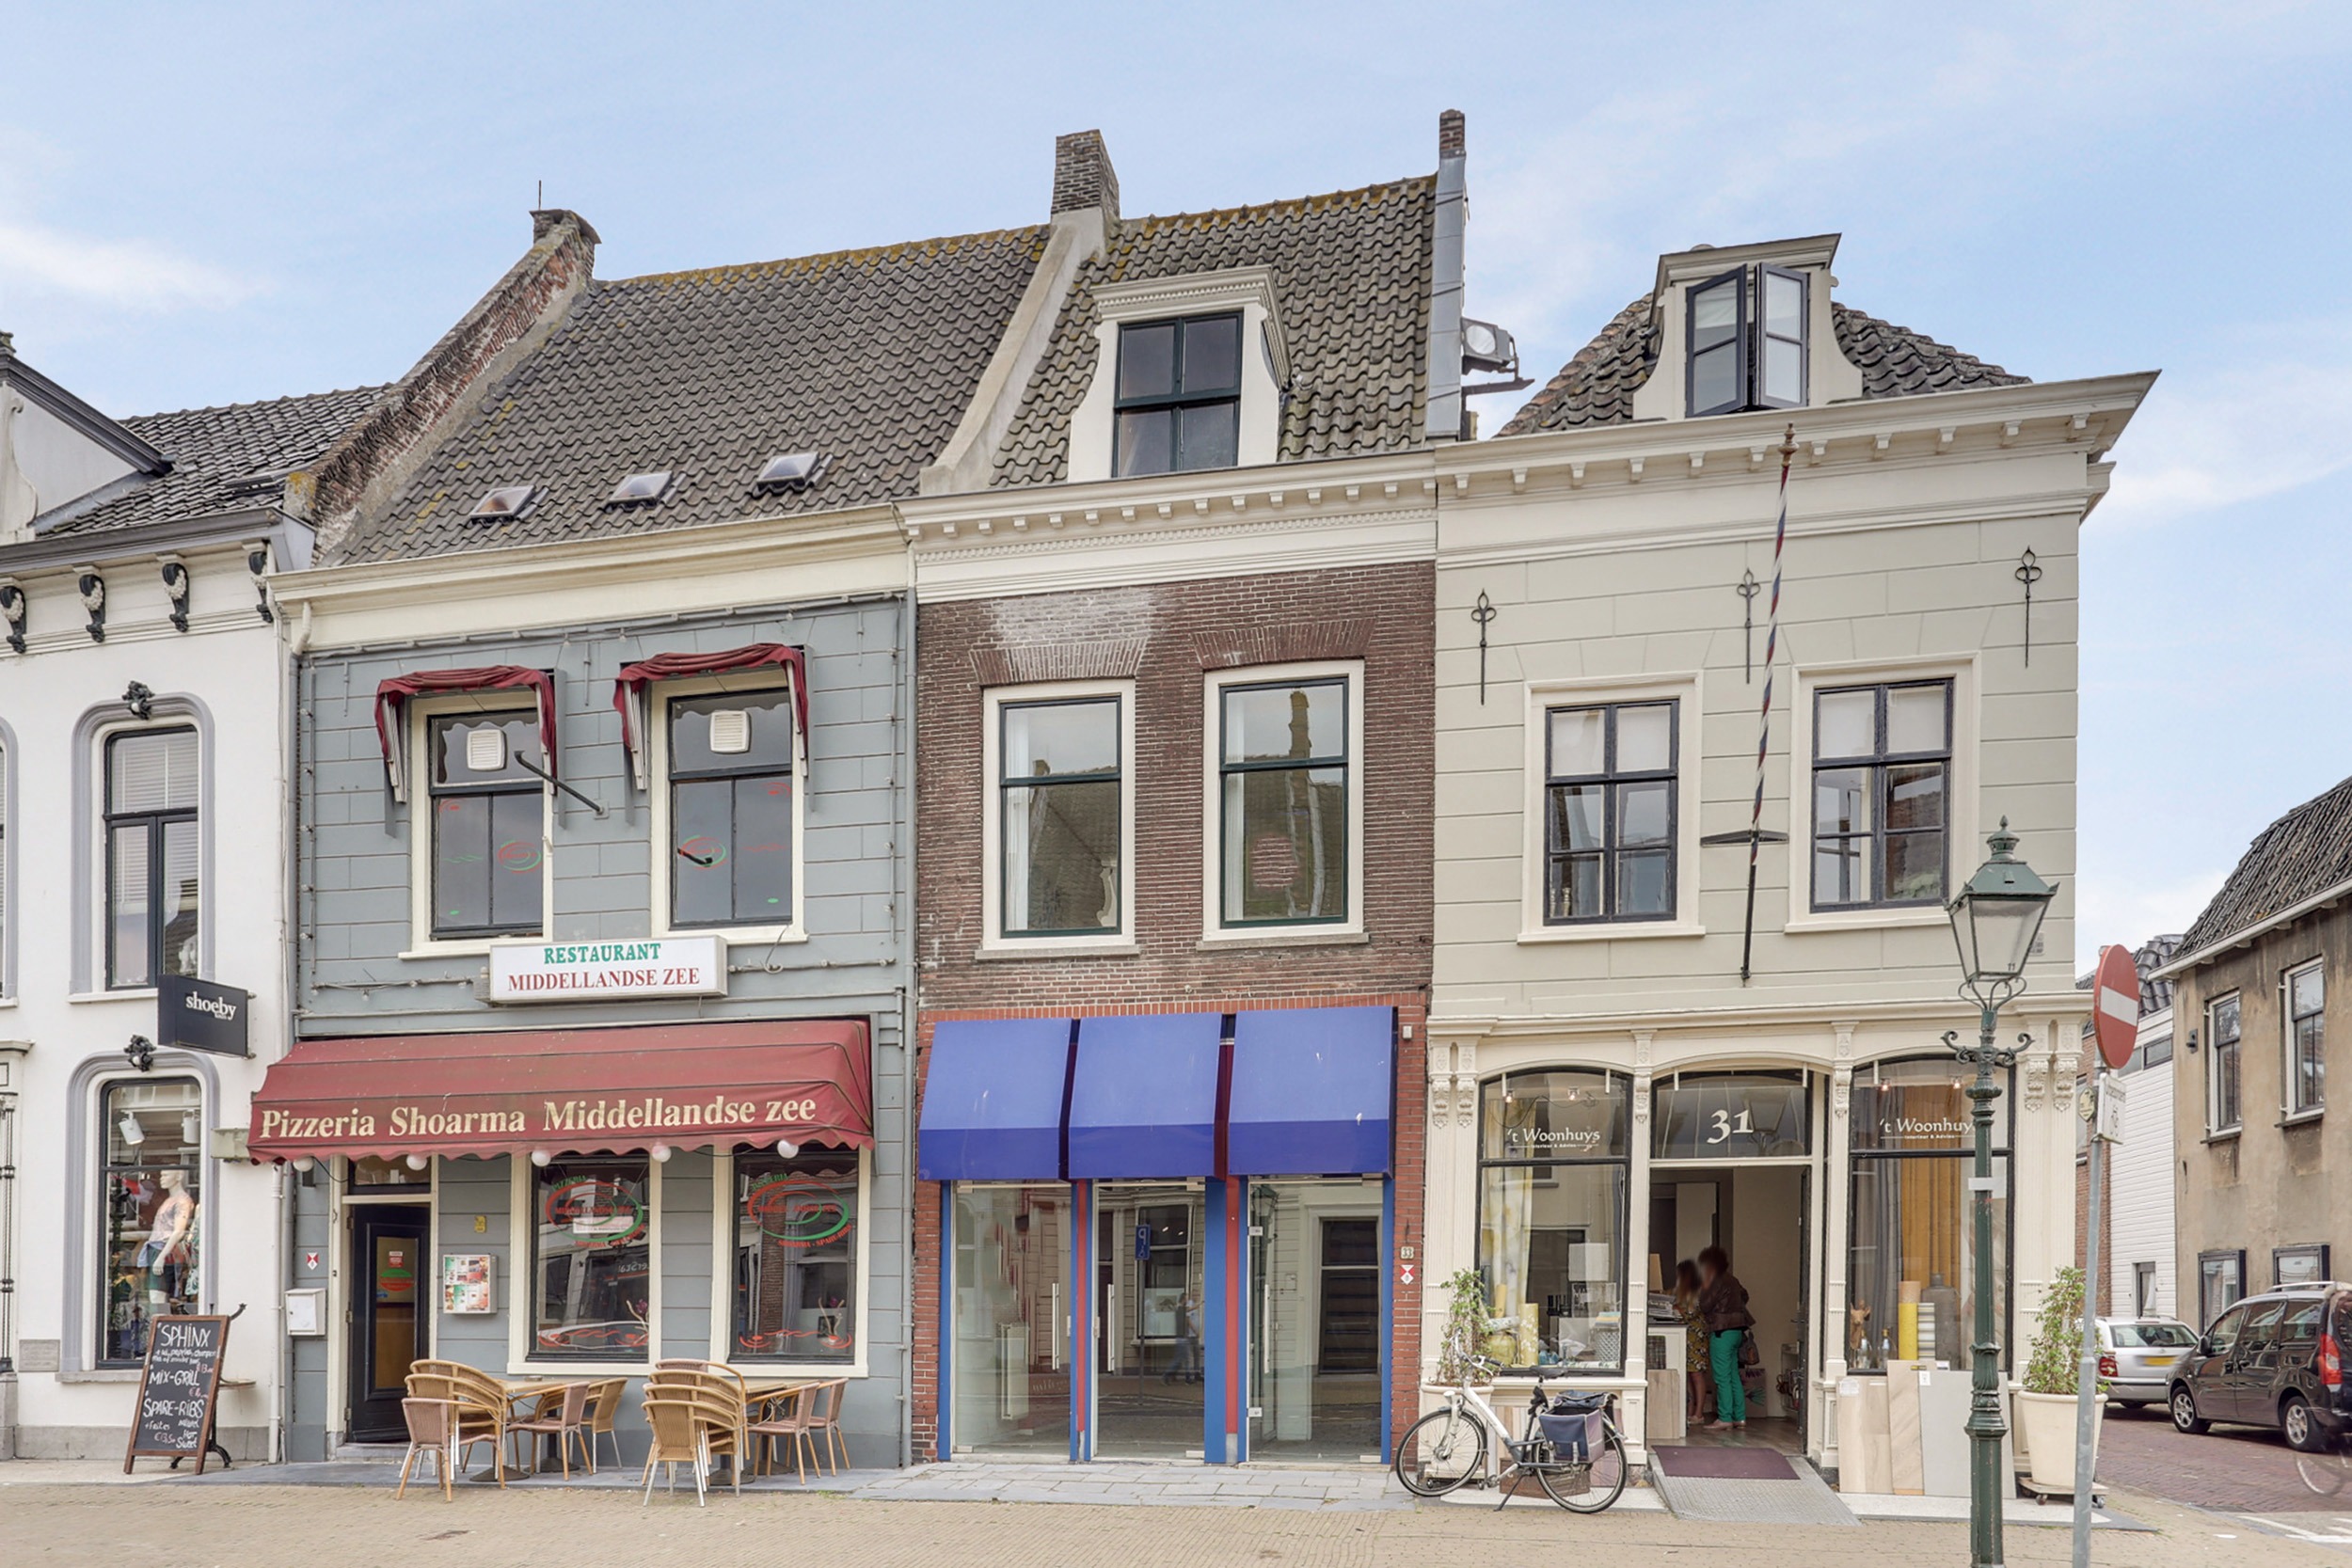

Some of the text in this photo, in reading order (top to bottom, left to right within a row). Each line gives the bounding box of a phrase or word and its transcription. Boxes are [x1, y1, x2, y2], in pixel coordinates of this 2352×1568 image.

[544, 942, 661, 964] RESTAURANT
[508, 967, 700, 991] MIDDELLANDSE ZEE
[185, 991, 236, 1021] shoeby
[259, 1096, 817, 1138] Pizzeria Shoarma Middellandse zee
[1707, 1109, 1754, 1144] 31
[1896, 1117, 1975, 1134] Woonhuy
[1523, 1127, 1600, 1143] Woonhuys
[1402, 1247, 1412, 1258] 33
